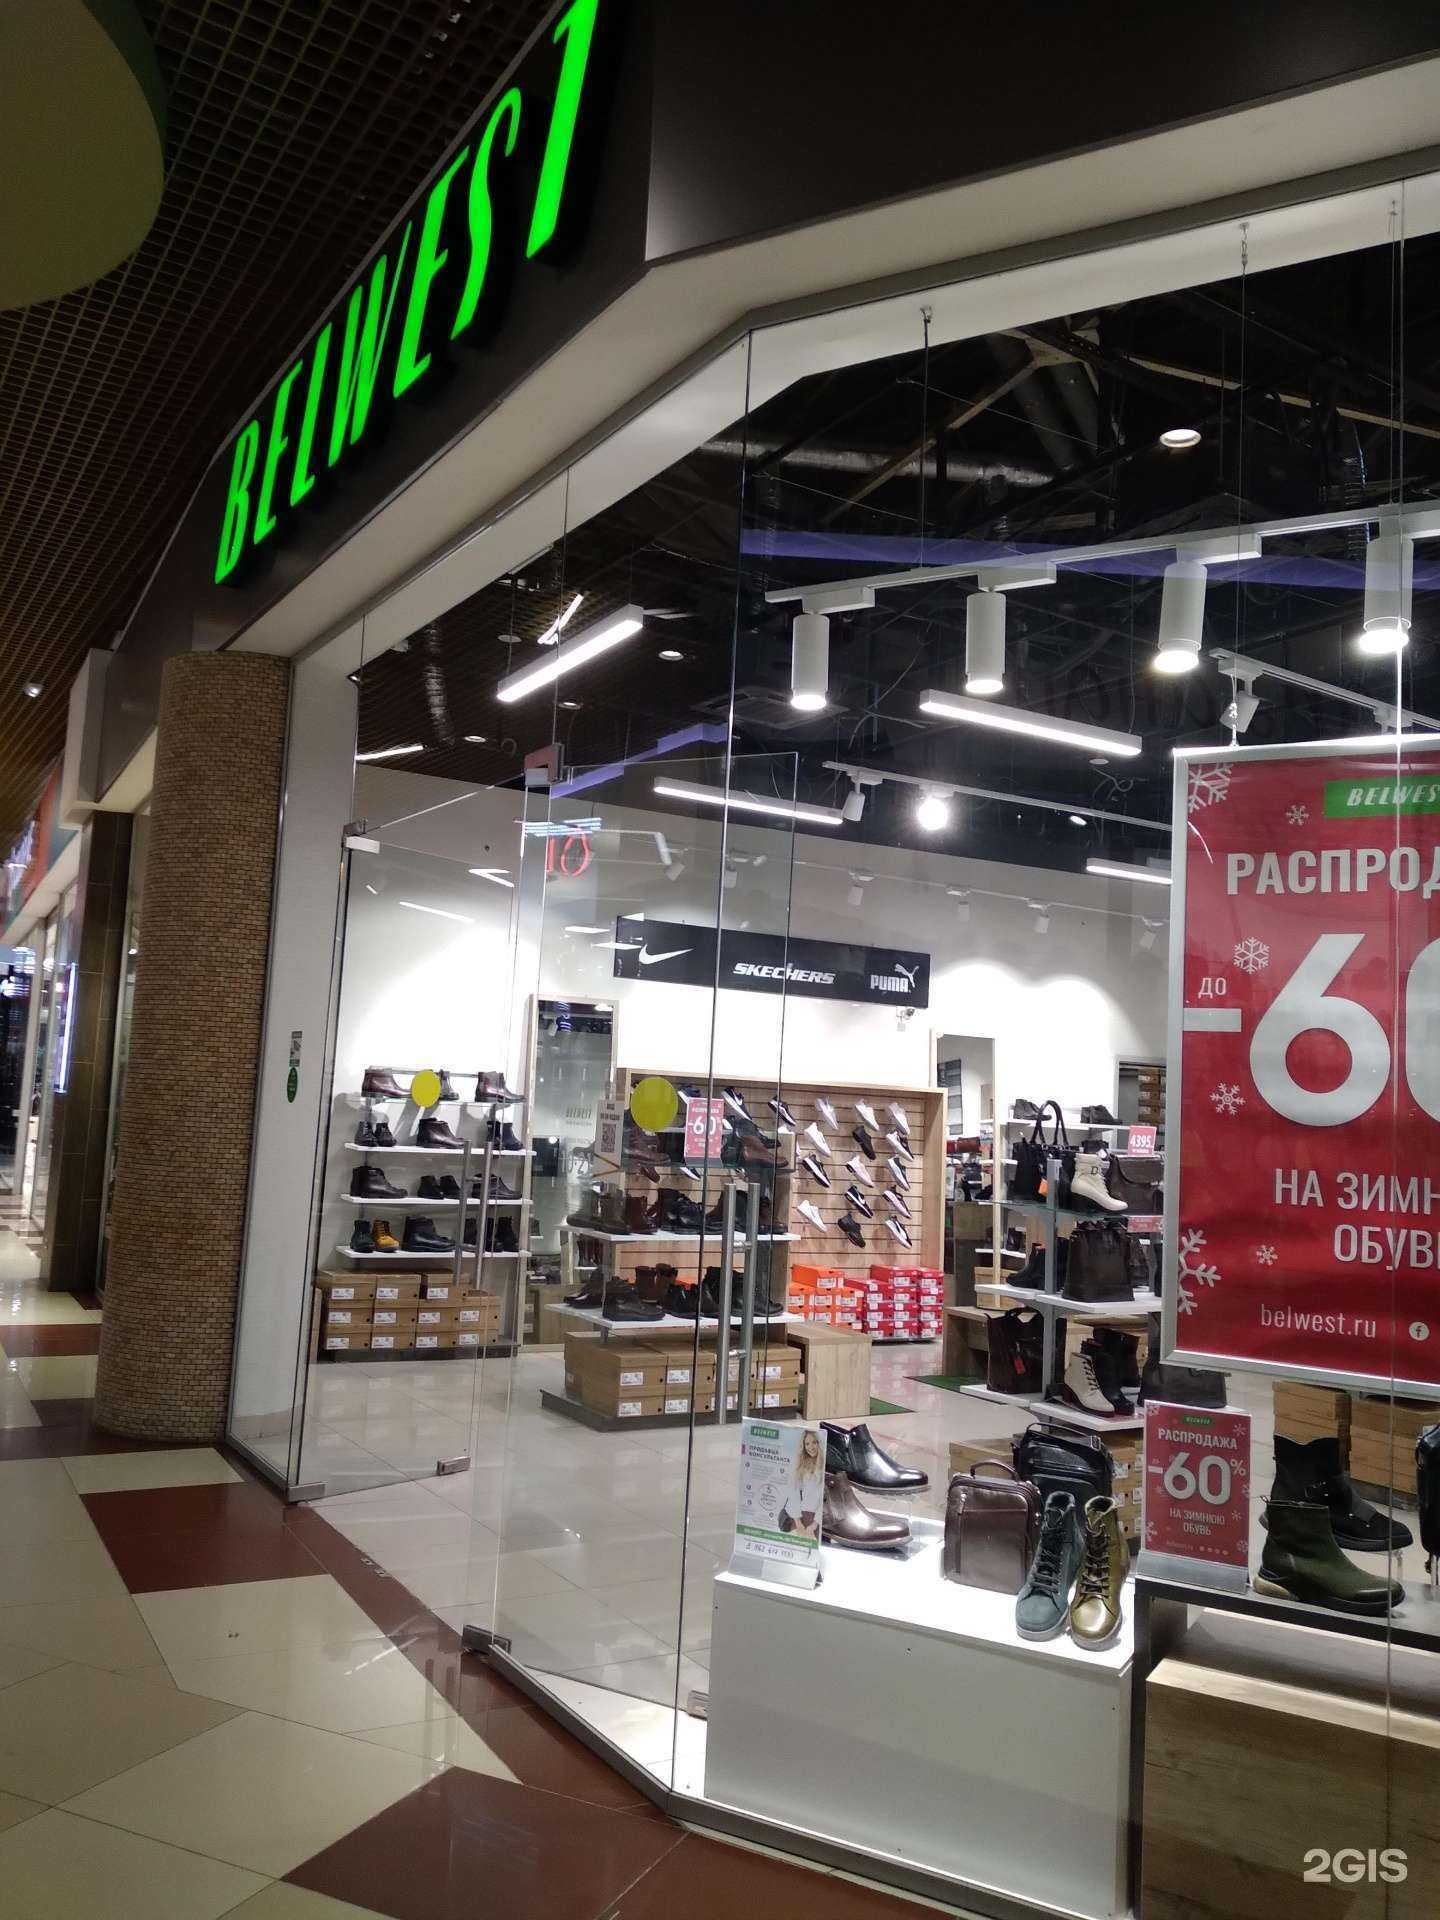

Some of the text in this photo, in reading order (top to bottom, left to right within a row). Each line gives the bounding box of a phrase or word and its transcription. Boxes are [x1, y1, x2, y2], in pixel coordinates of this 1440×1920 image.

[214, 0, 600, 585] BELWEST
[732, 962, 909, 993] SKECHERS PUMA
[1182, 932, 1440, 1127] -6
[1274, 1168, 1440, 1215] НА ЗИМН
[1334, 1224, 1440, 1271] ОБУВ
[1261, 1303, 1377, 1338] belwest.ru
[1157, 1427, 1238, 1450] РАСПРОДАЖА
[1169, 1508, 1226, 1525] НА ЗИМНЮЮ
[1183, 1522, 1212, 1536] ОБУВЬ
